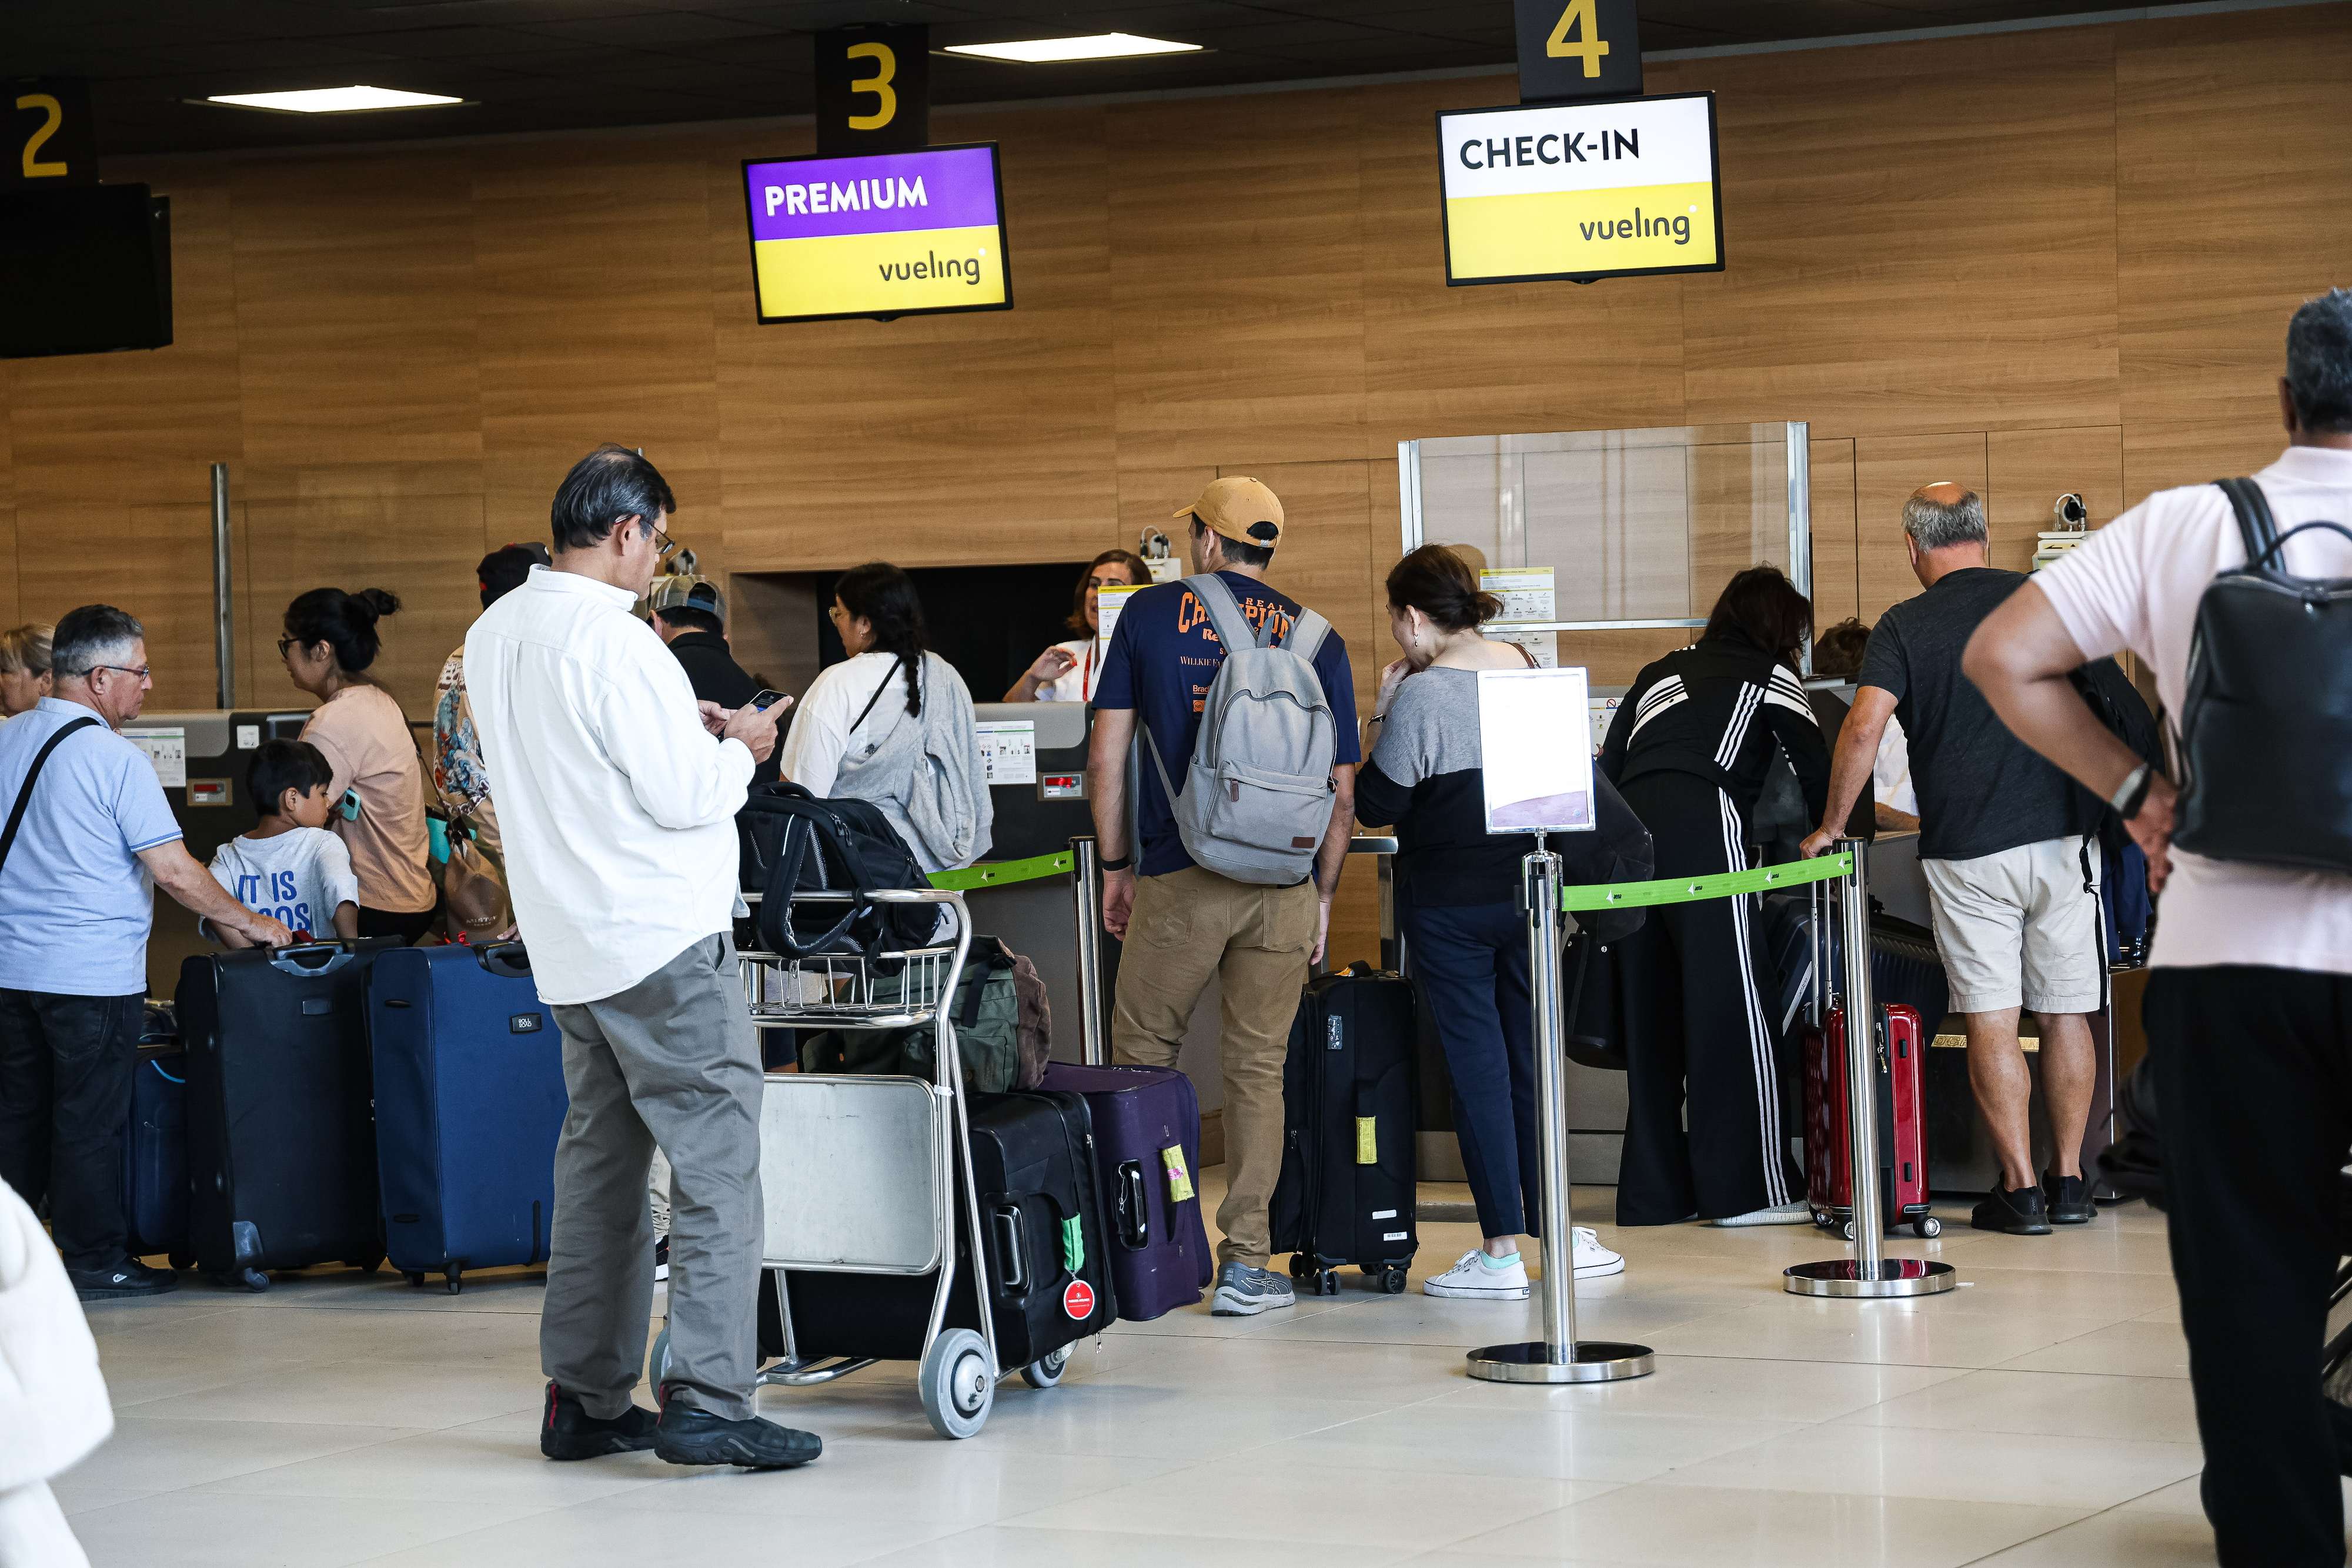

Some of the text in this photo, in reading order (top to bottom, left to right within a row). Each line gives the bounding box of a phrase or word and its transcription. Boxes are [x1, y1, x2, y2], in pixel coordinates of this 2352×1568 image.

[1546, 0, 1609, 78] 4
[847, 42, 897, 131] 3
[15, 94, 68, 178] 2
[1460, 128, 1639, 169] CHECK-IN
[764, 175, 928, 216] PREMIUM
[1579, 207, 1690, 245] vueling
[878, 250, 981, 285] vueling
[1245, 597, 1285, 613] REAL
[238, 871, 297, 903] IT IS
